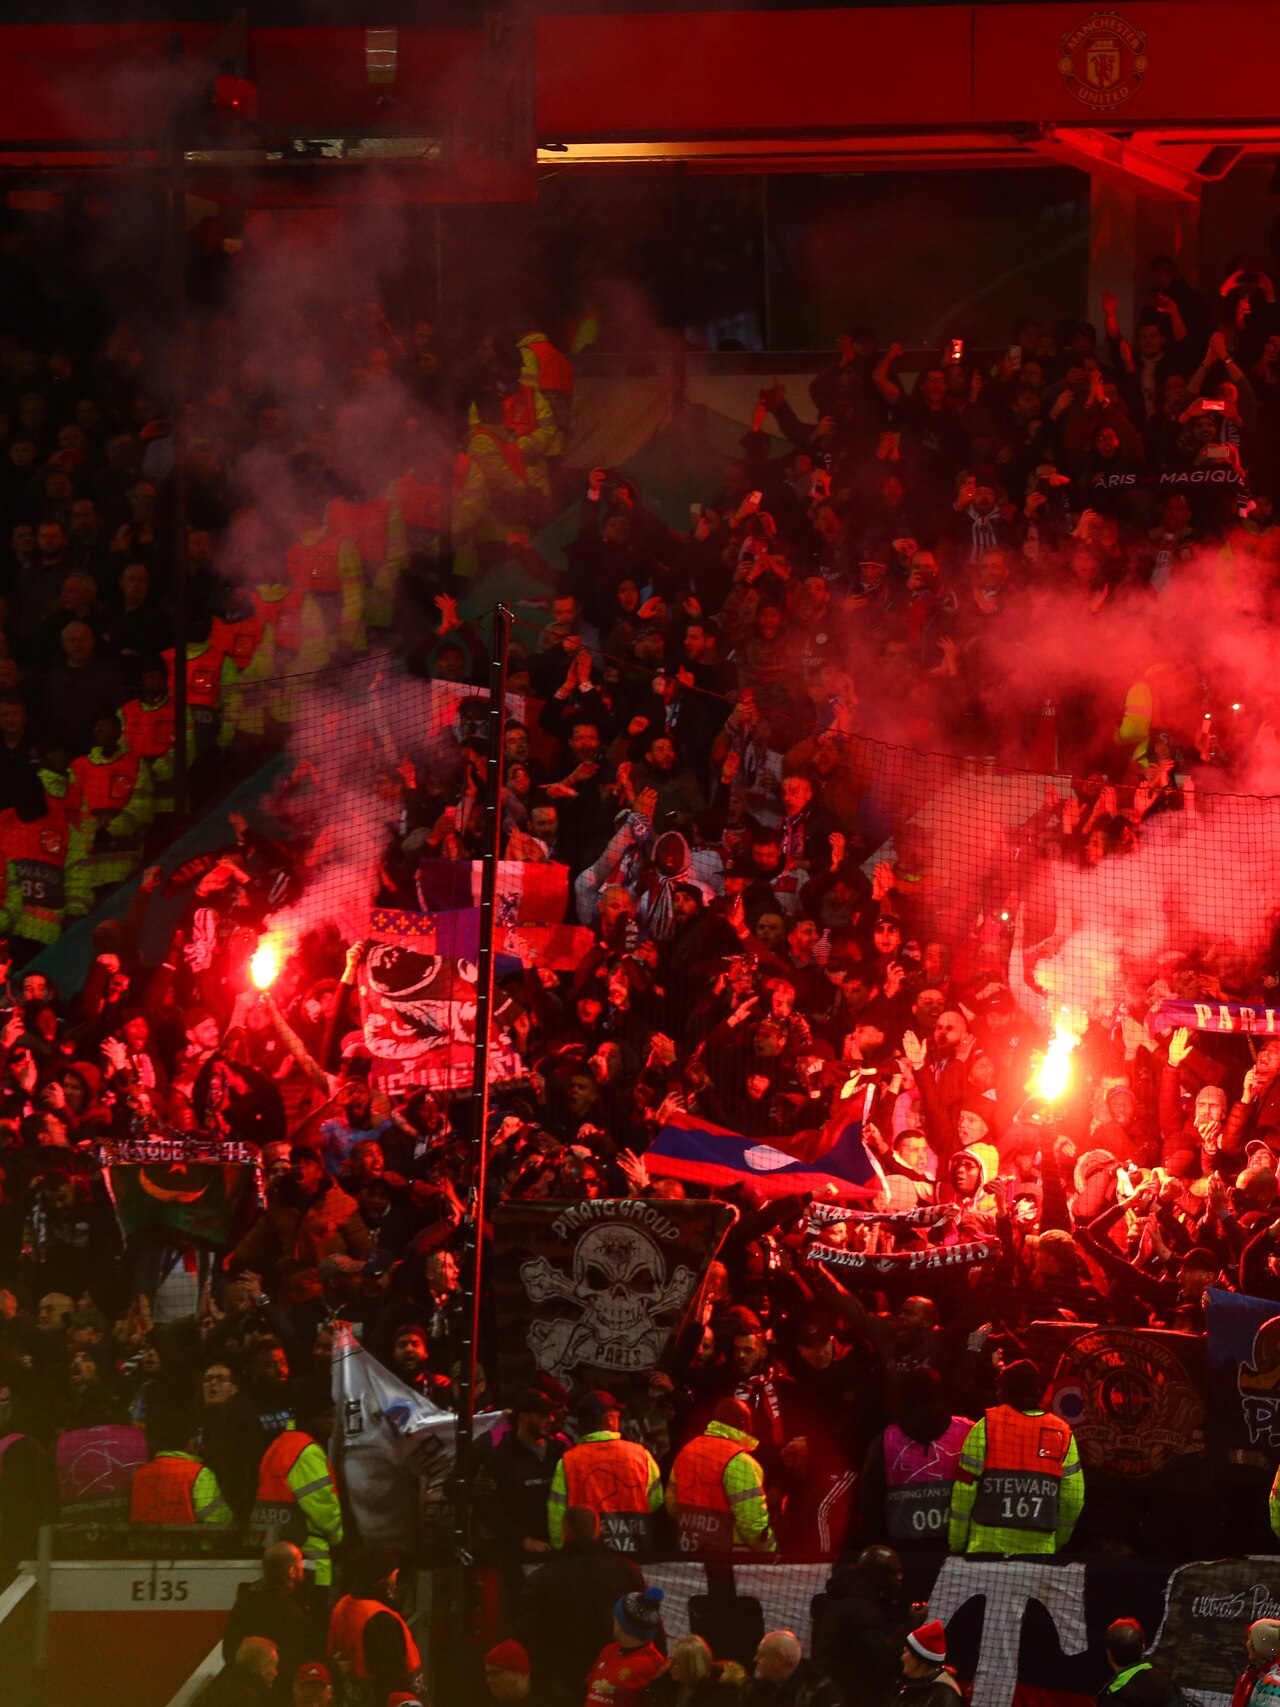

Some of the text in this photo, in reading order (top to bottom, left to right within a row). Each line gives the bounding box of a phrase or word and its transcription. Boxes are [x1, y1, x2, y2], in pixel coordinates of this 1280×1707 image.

[1066, 18, 1140, 50] MANCHESTER
[1078, 87, 1129, 103] UNITED
[1094, 469, 1239, 489] ARIS MAGIQU
[618, 1200, 680, 1240] GROUP
[908, 1243, 990, 1271] PARIS
[595, 1347, 642, 1367] PARIS
[983, 1477, 1058, 1496] STEWARD
[1002, 1497, 1044, 1519] 167
[131, 1580, 190, 1601] E135
